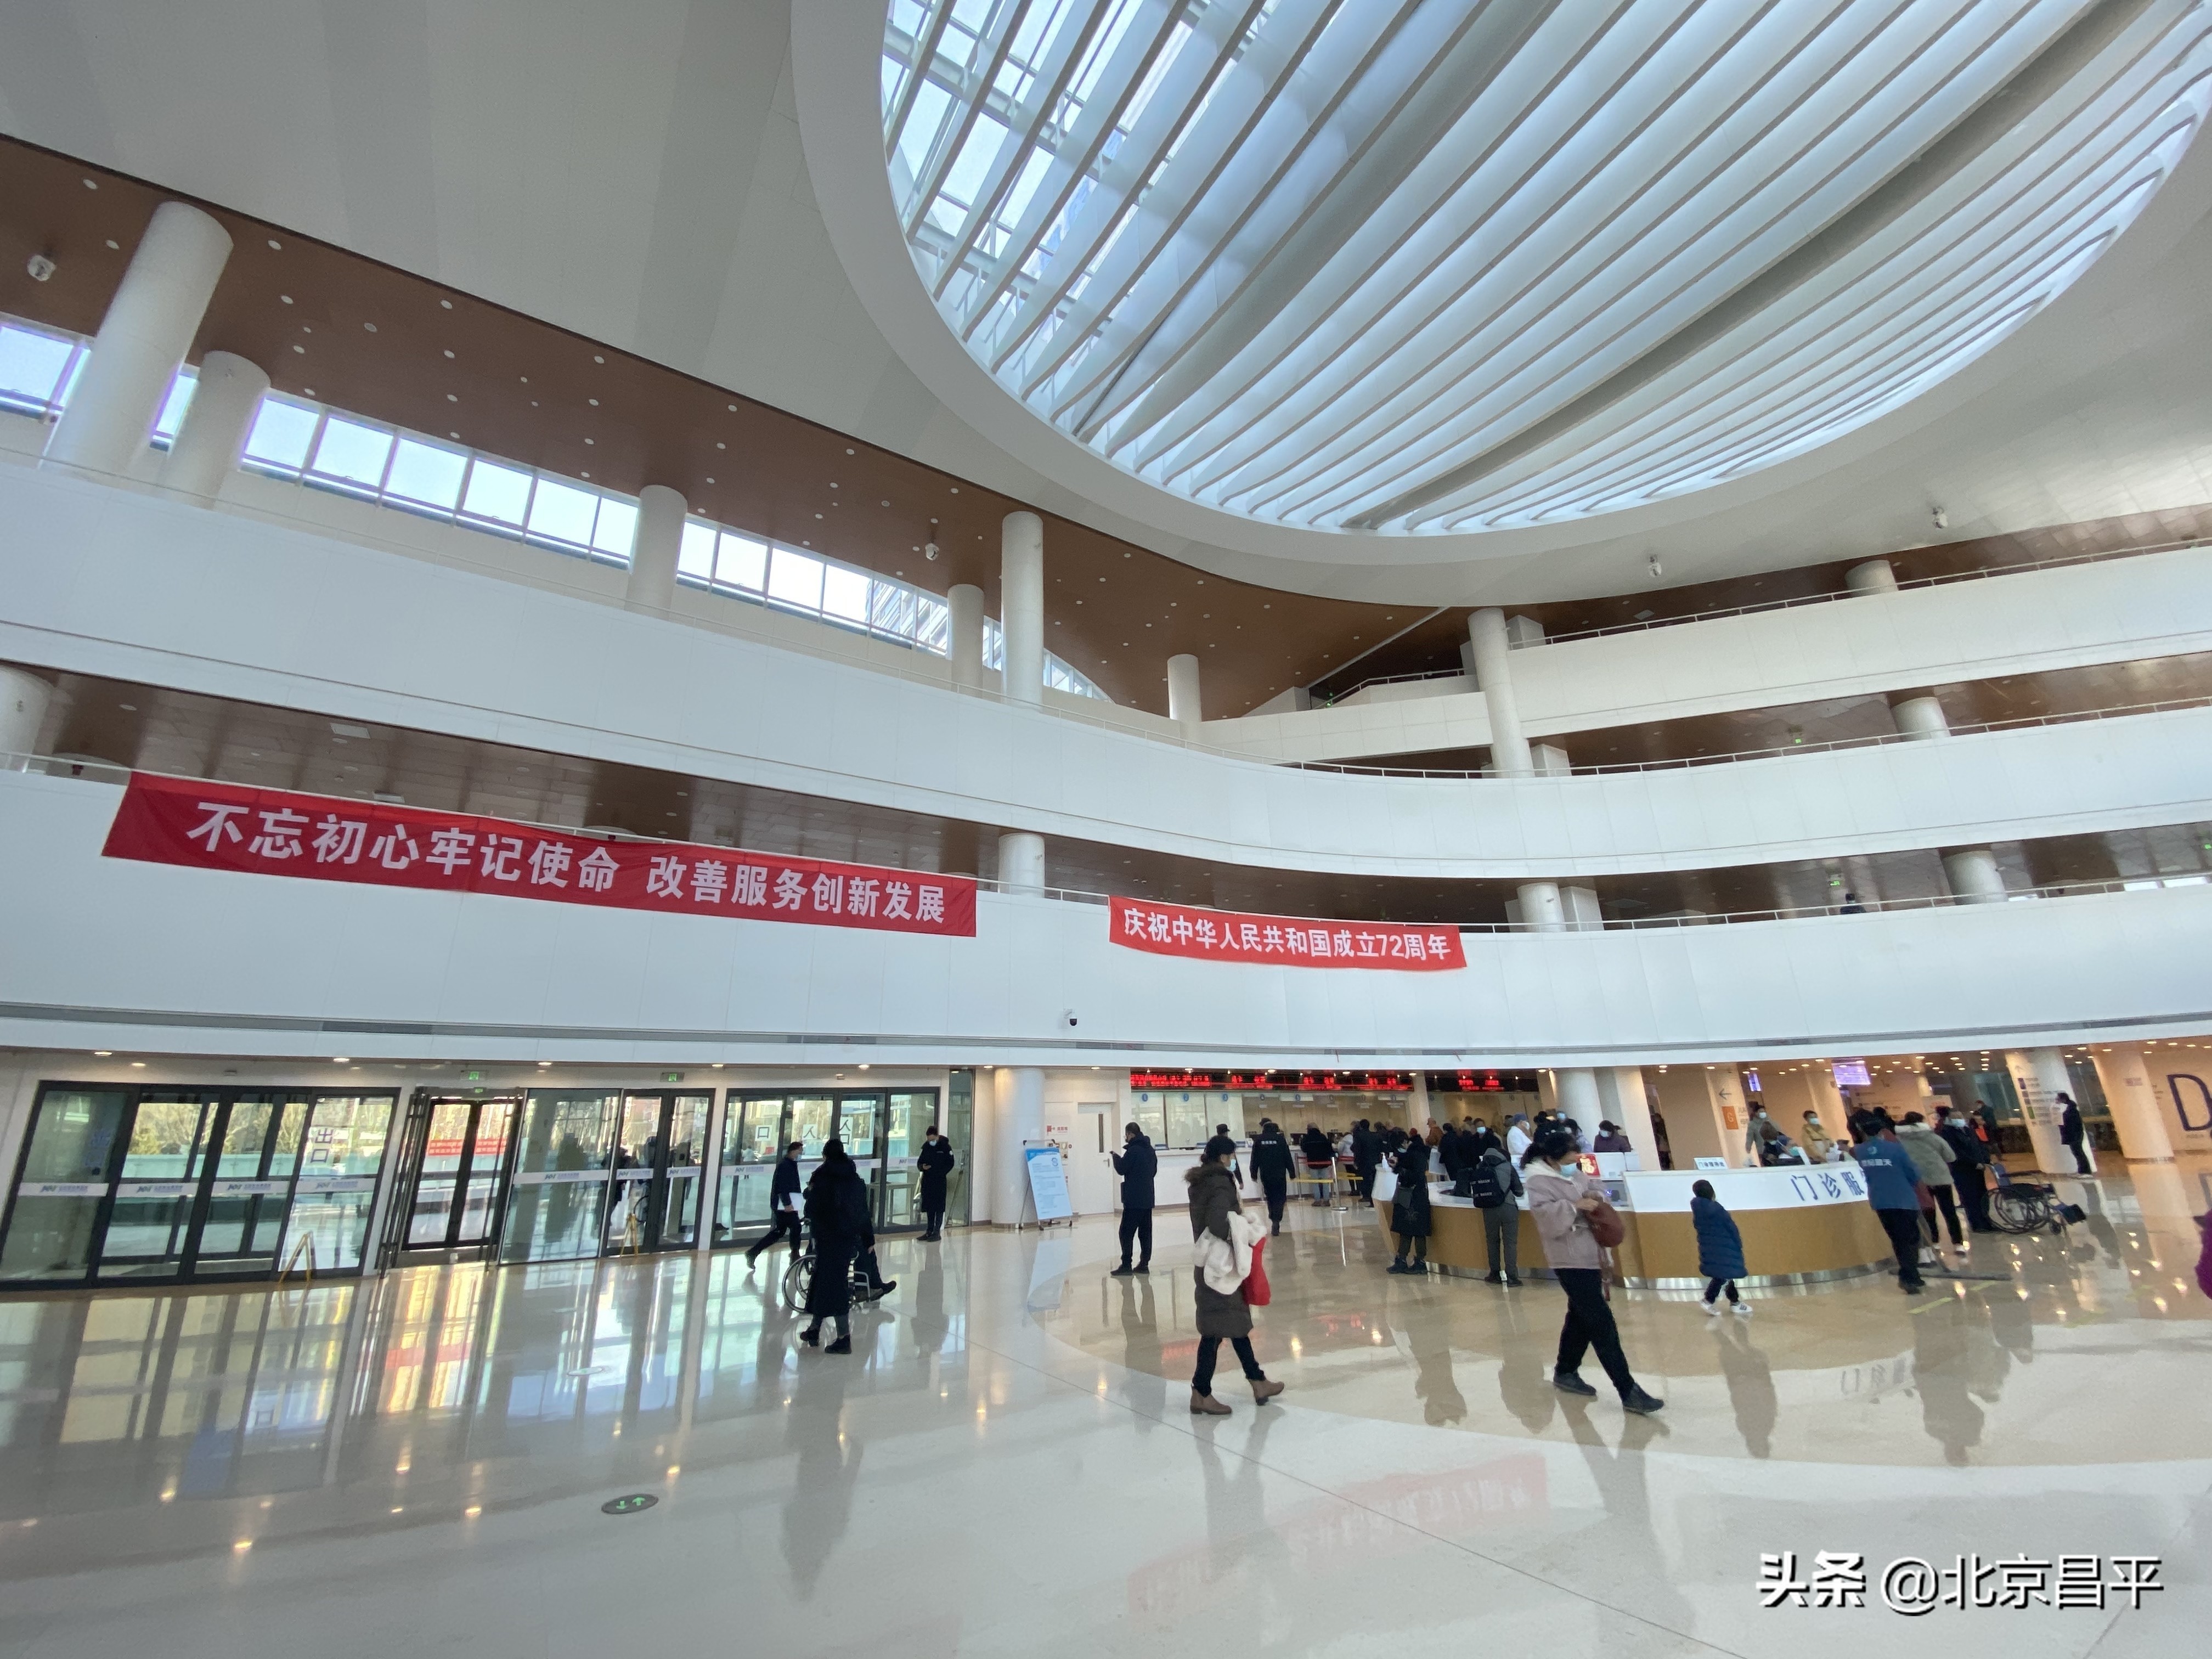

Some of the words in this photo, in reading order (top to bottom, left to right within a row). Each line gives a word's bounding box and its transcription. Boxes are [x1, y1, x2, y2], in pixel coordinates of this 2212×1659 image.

[187, 802, 620, 893] 不忘初心牢记使命
[646, 855, 945, 924] 改善服务创新发展
[1124, 907, 1451, 961] 庆祝中华人民共和国成立72周年
